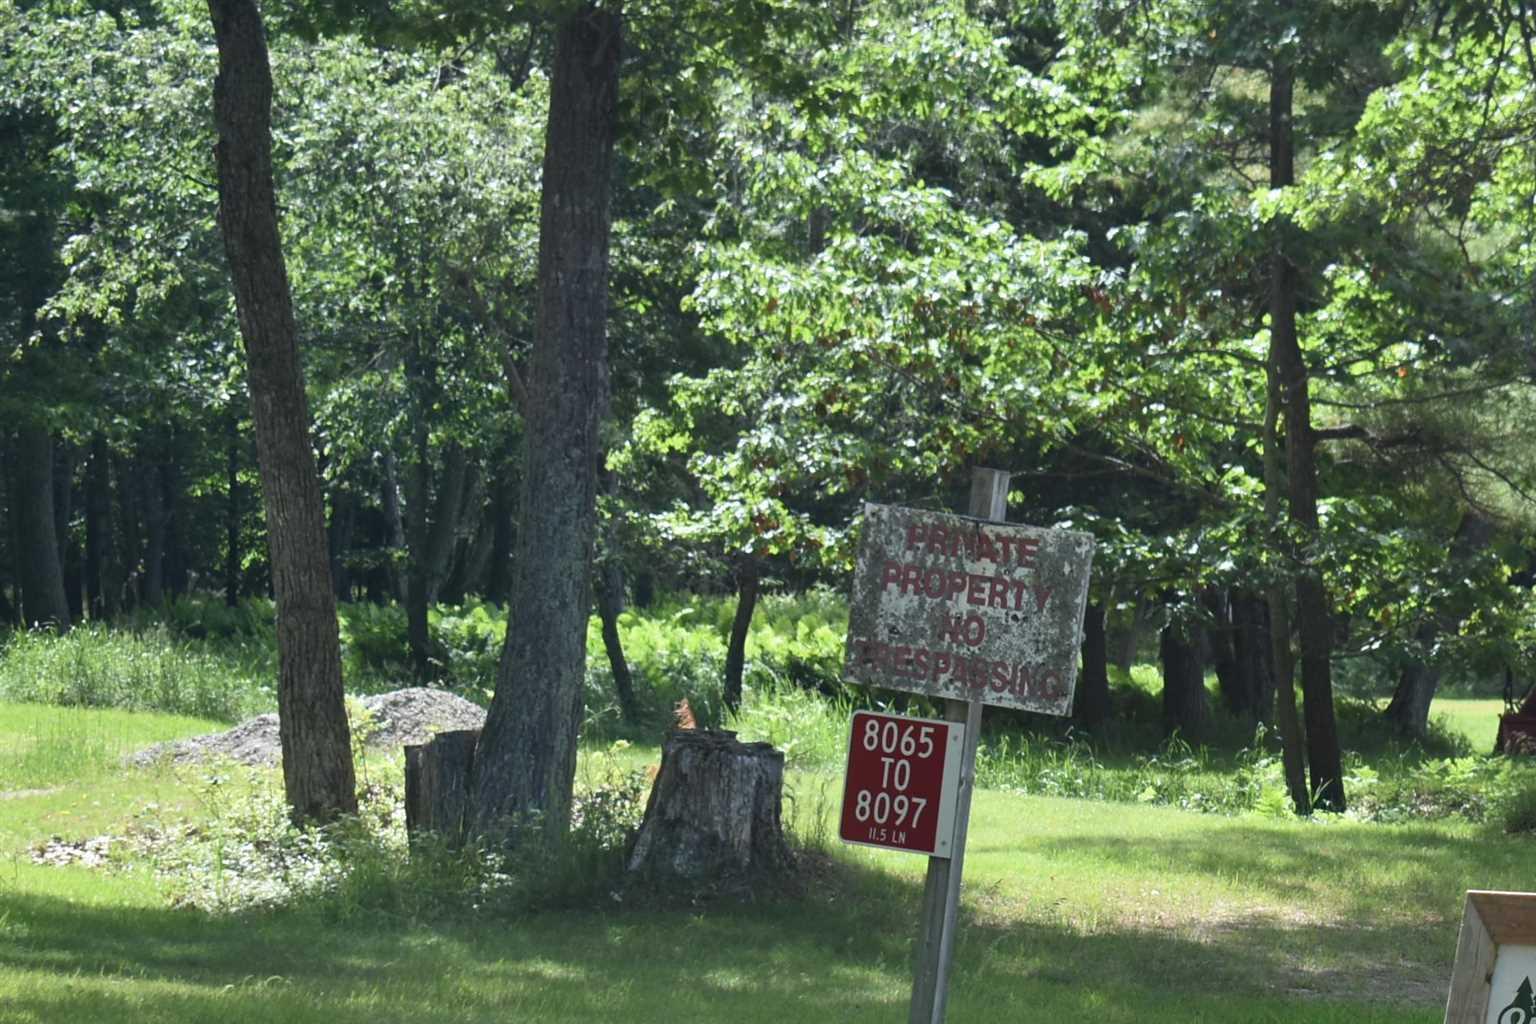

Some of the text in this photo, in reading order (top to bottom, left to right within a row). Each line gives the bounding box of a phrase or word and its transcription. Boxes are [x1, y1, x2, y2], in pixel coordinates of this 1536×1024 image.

[906, 522, 1041, 569] PRIVATE
[881, 559, 1053, 611] PROPERTY
[938, 611, 987, 648] NO
[853, 639, 1062, 700] TRESPASSING
[863, 719, 935, 759] 8065
[881, 757, 911, 791] TO
[855, 789, 928, 829] 8097
[891, 829, 906, 845] LN
